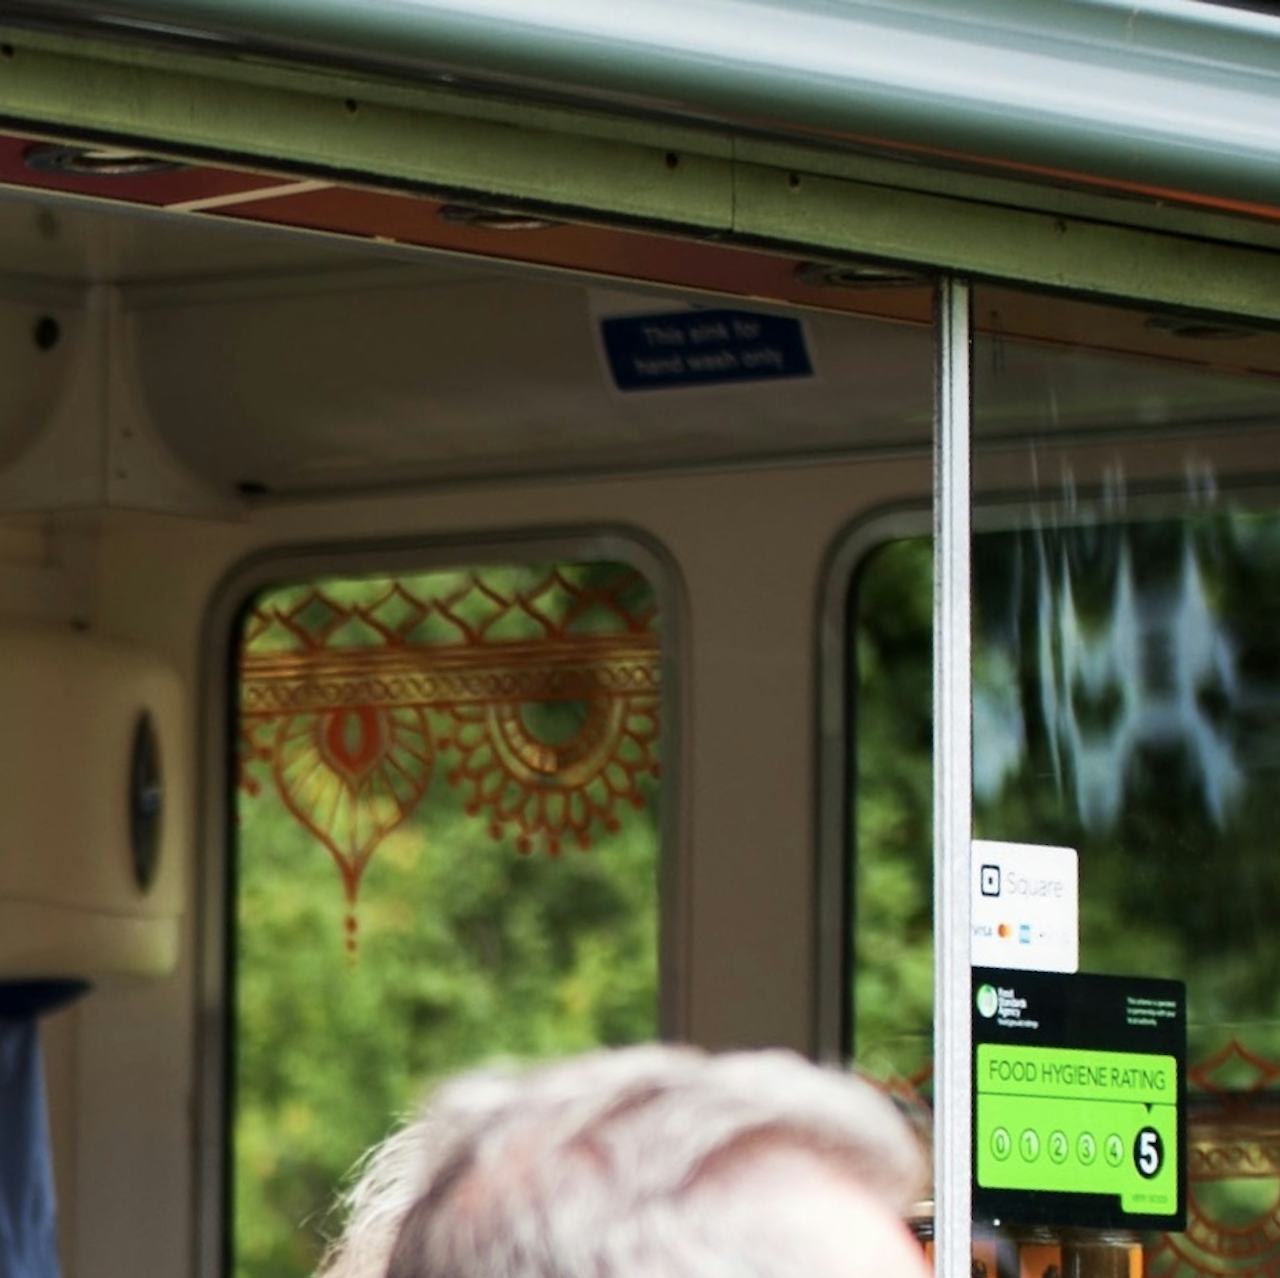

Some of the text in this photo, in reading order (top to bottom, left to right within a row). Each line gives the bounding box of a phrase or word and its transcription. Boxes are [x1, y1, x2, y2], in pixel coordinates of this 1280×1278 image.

[1007, 871, 1063, 900] Square
[989, 1060, 1166, 1091] FOOD HYGIENE RATING
[1139, 1131, 1160, 1175] 5
